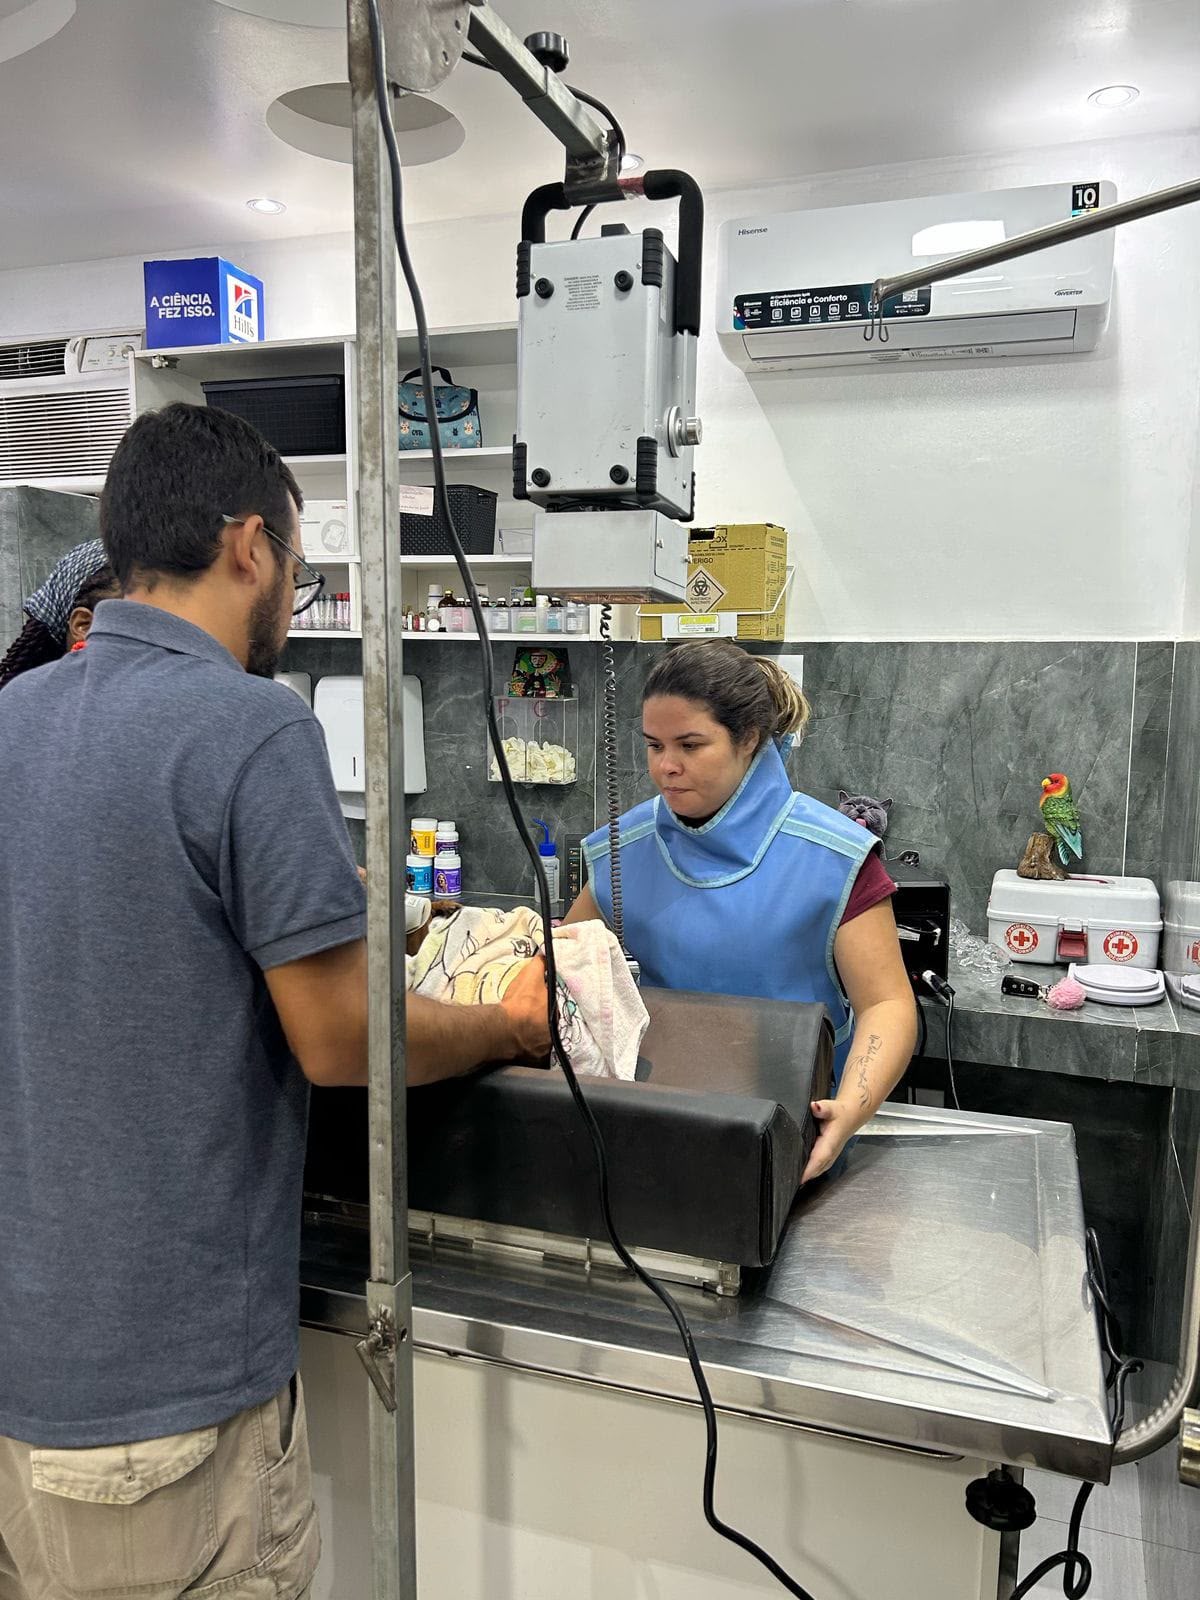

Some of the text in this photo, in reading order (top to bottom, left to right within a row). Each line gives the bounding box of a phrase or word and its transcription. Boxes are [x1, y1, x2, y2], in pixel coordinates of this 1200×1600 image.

[1075, 188, 1096, 206] 10
[150, 292, 212, 308] A CIÊNCIA
[770, 298, 806, 307] Eficiência
[813, 294, 848, 303] Conforto
[158, 305, 215, 319] FEZ ISSO.
